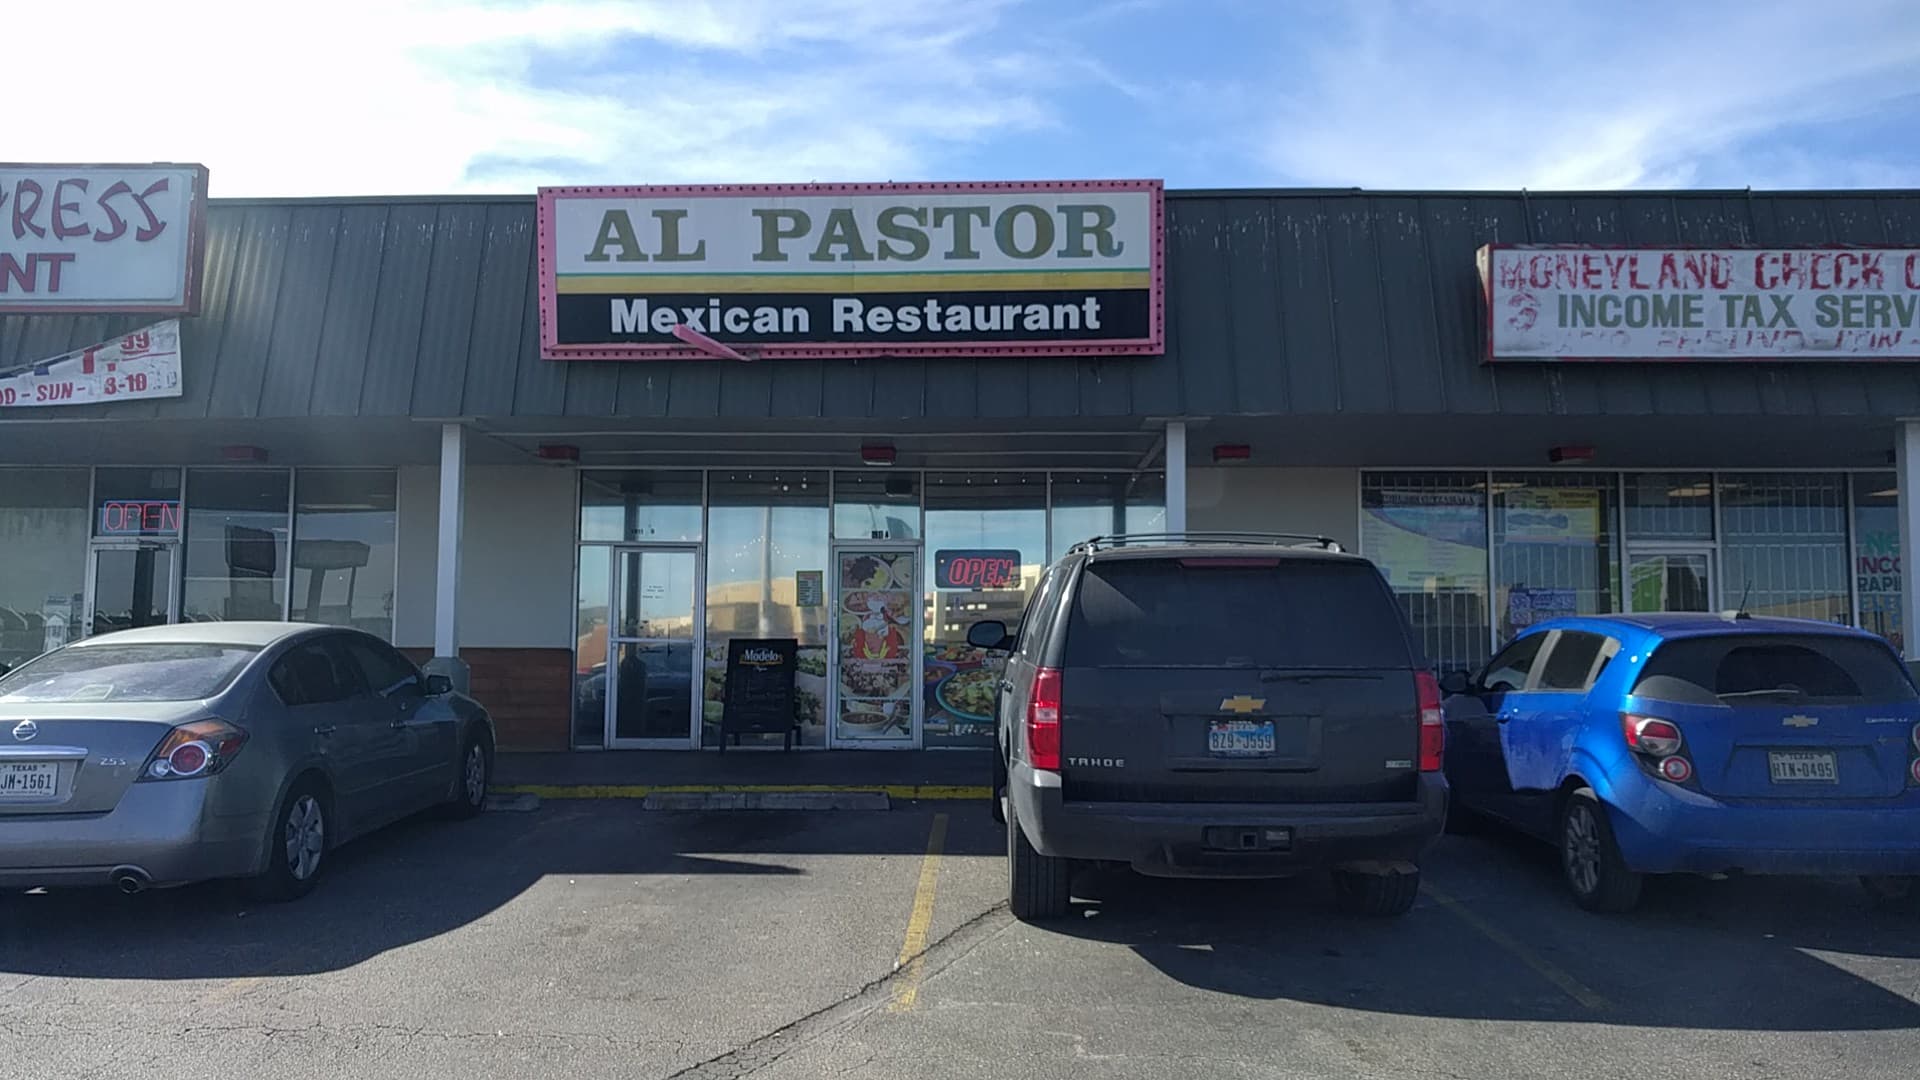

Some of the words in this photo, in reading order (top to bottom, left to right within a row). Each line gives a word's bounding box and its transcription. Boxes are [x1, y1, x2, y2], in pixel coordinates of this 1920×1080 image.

[0, 178, 169, 242] RESS
[584, 208, 706, 263] AL
[752, 203, 1124, 262] PASTOR
[1755, 252, 1884, 290] CHECK
[610, 297, 810, 334] Mexican
[832, 296, 1101, 333] Restaurant
[1557, 294, 1705, 329] INCOME
[1719, 294, 1798, 329] TAX
[36, 382, 74, 401] SUN
[106, 503, 181, 532] OPEN
[949, 558, 1014, 585] OPEN
[744, 648, 778, 662] Modelo
[12, 764, 38, 772] TEXAS
[1067, 757, 1125, 768] TAHOE
